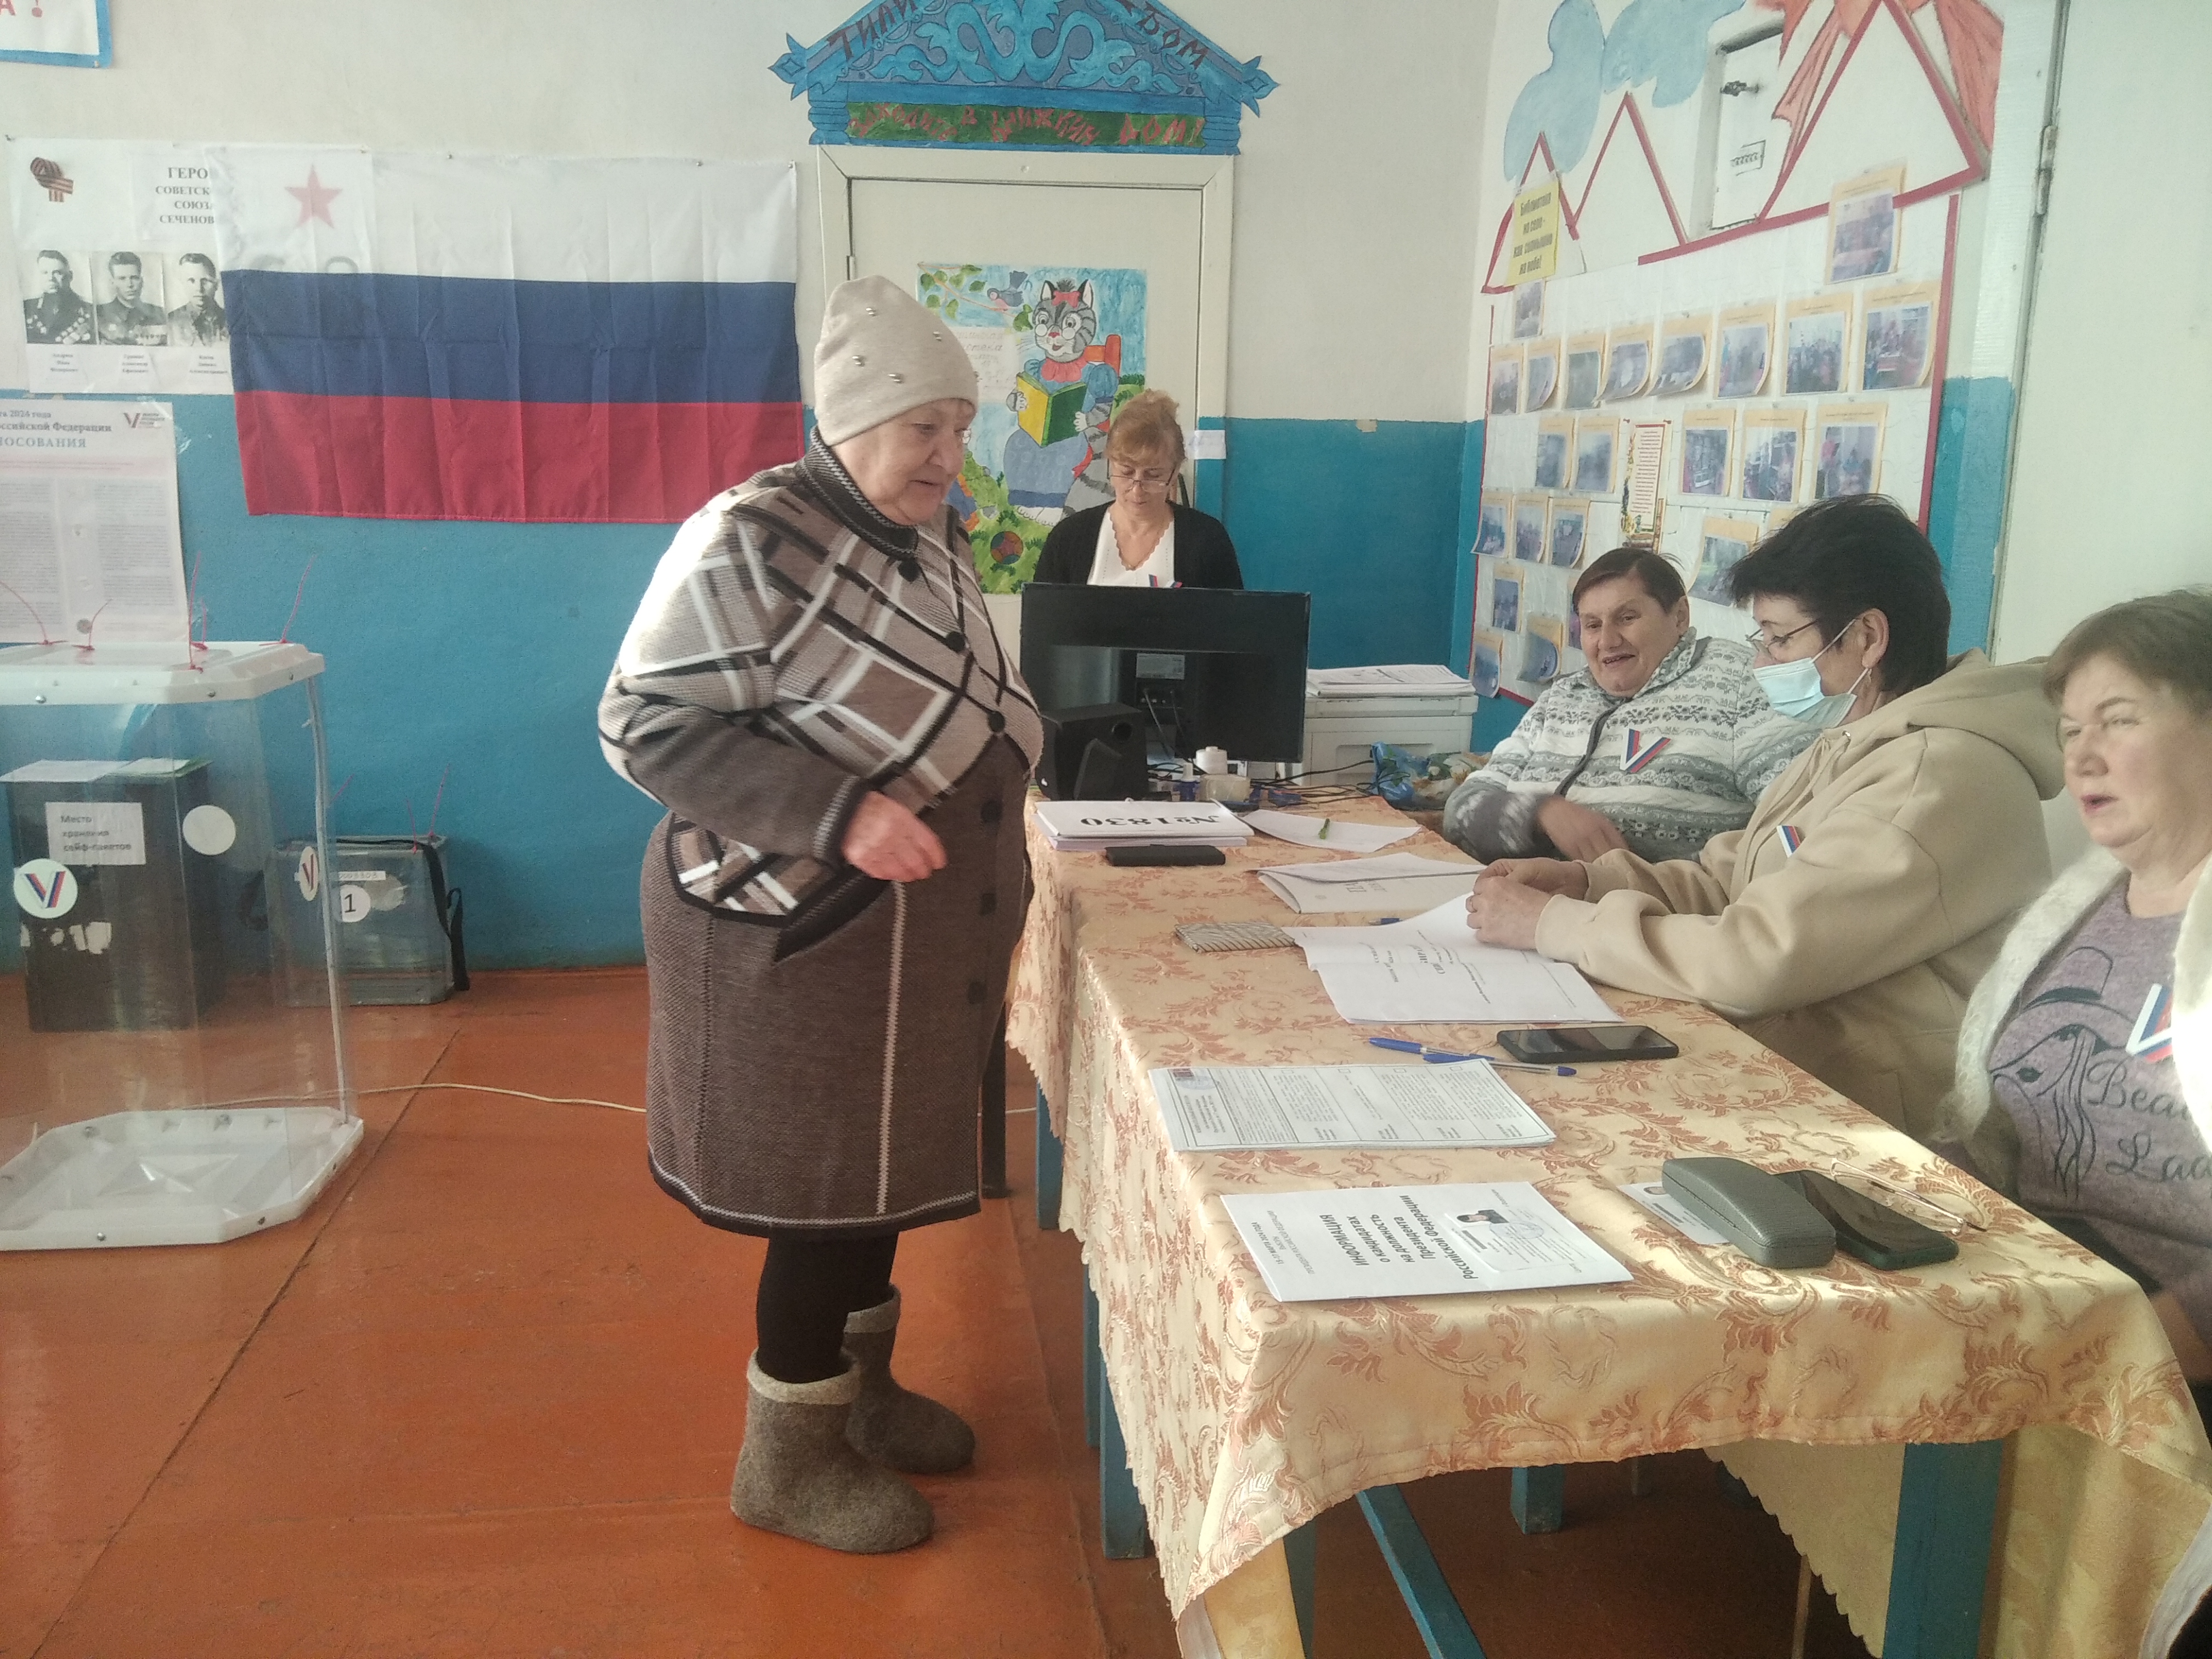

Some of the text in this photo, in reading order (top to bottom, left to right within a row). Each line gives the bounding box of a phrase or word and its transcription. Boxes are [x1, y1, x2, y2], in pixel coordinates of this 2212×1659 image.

[174, 200, 212, 210] СОЮЗ
[53, 421, 112, 434] Федерации
[60, 815, 93, 823] Место
[345, 893, 357, 913] 1
[1320, 1215, 1369, 1265] ИНФОРМАЦИЯ
[1347, 1216, 1386, 1256] кандидатах
[1370, 1215, 1415, 1262] на должность
[1394, 1217, 1435, 1259] Президента
[1400, 1195, 1478, 1279] Российской Федерации
